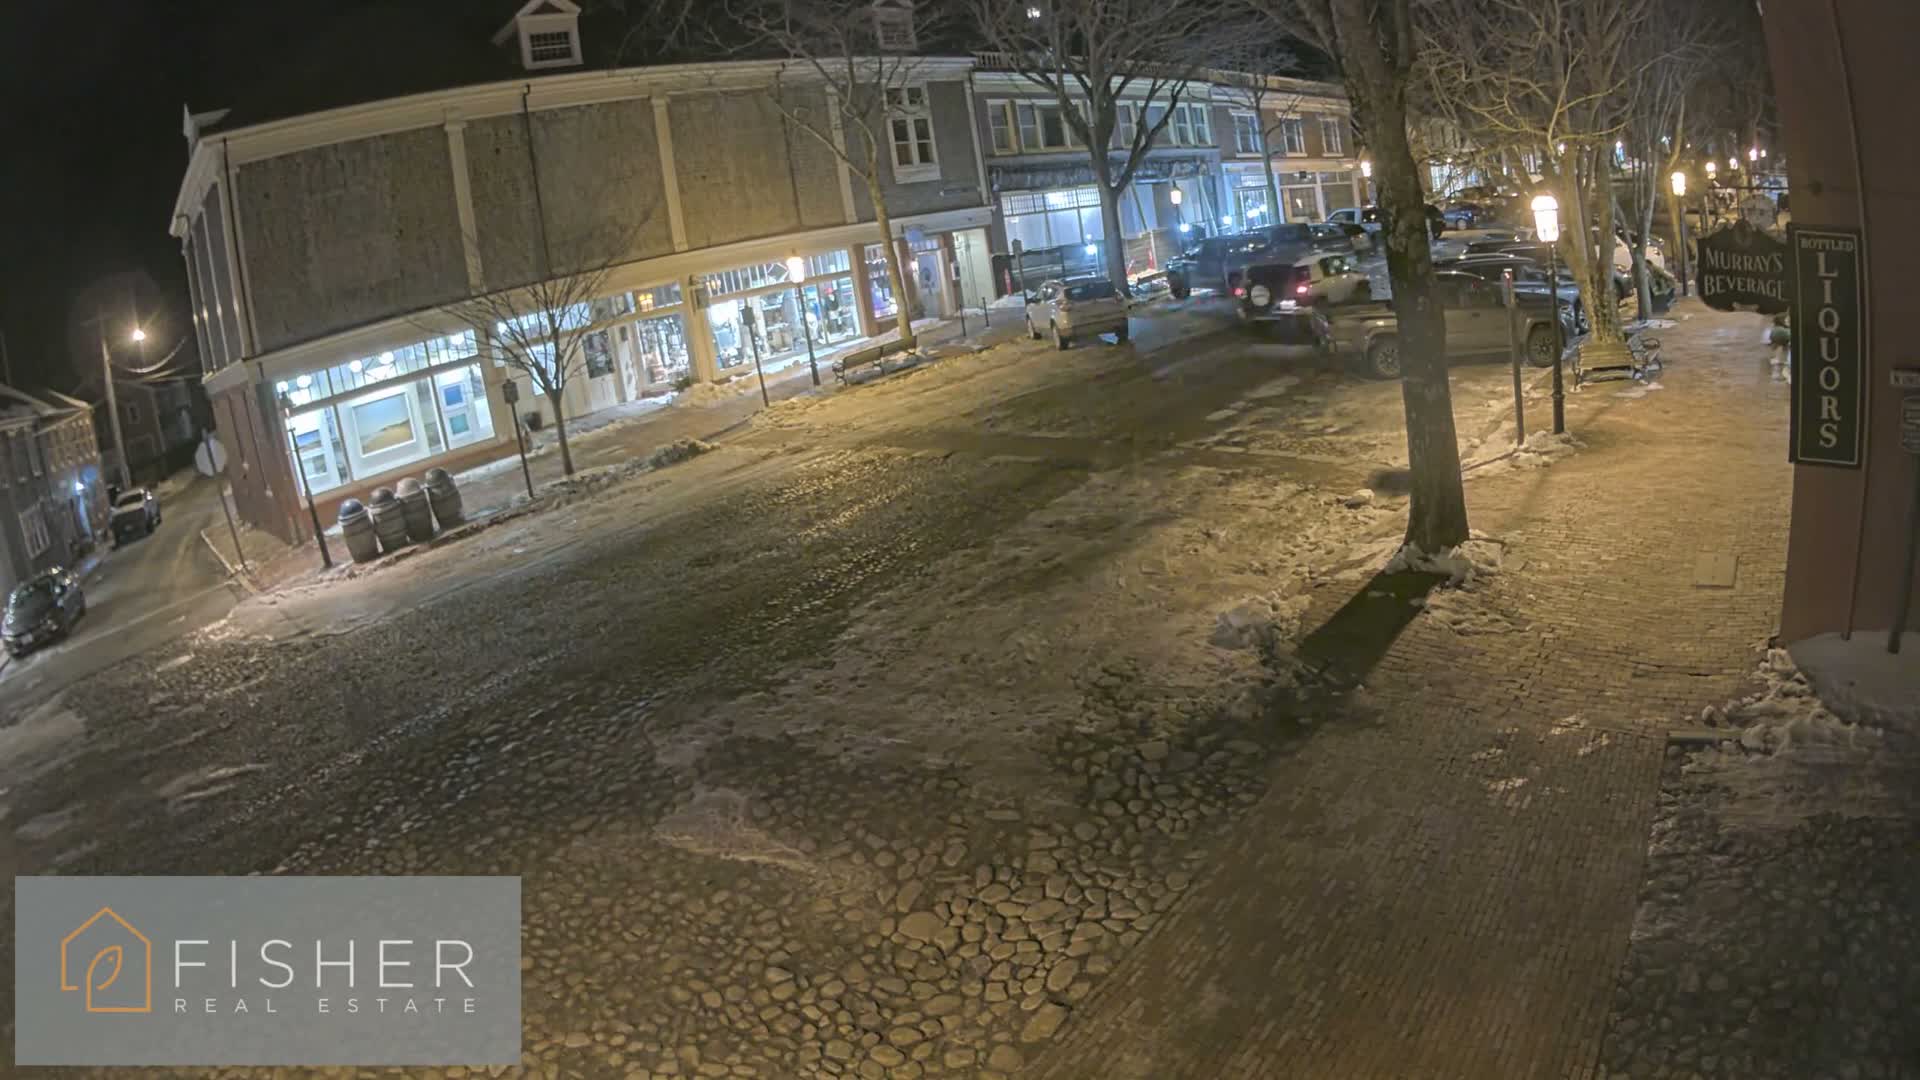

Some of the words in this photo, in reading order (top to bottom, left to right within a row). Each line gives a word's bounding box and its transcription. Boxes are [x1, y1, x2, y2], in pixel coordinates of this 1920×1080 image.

[1799, 237, 1854, 252] BOTTLED
[1704, 247, 1784, 273] MURRAY'S
[1816, 251, 1842, 448] LIQUORS
